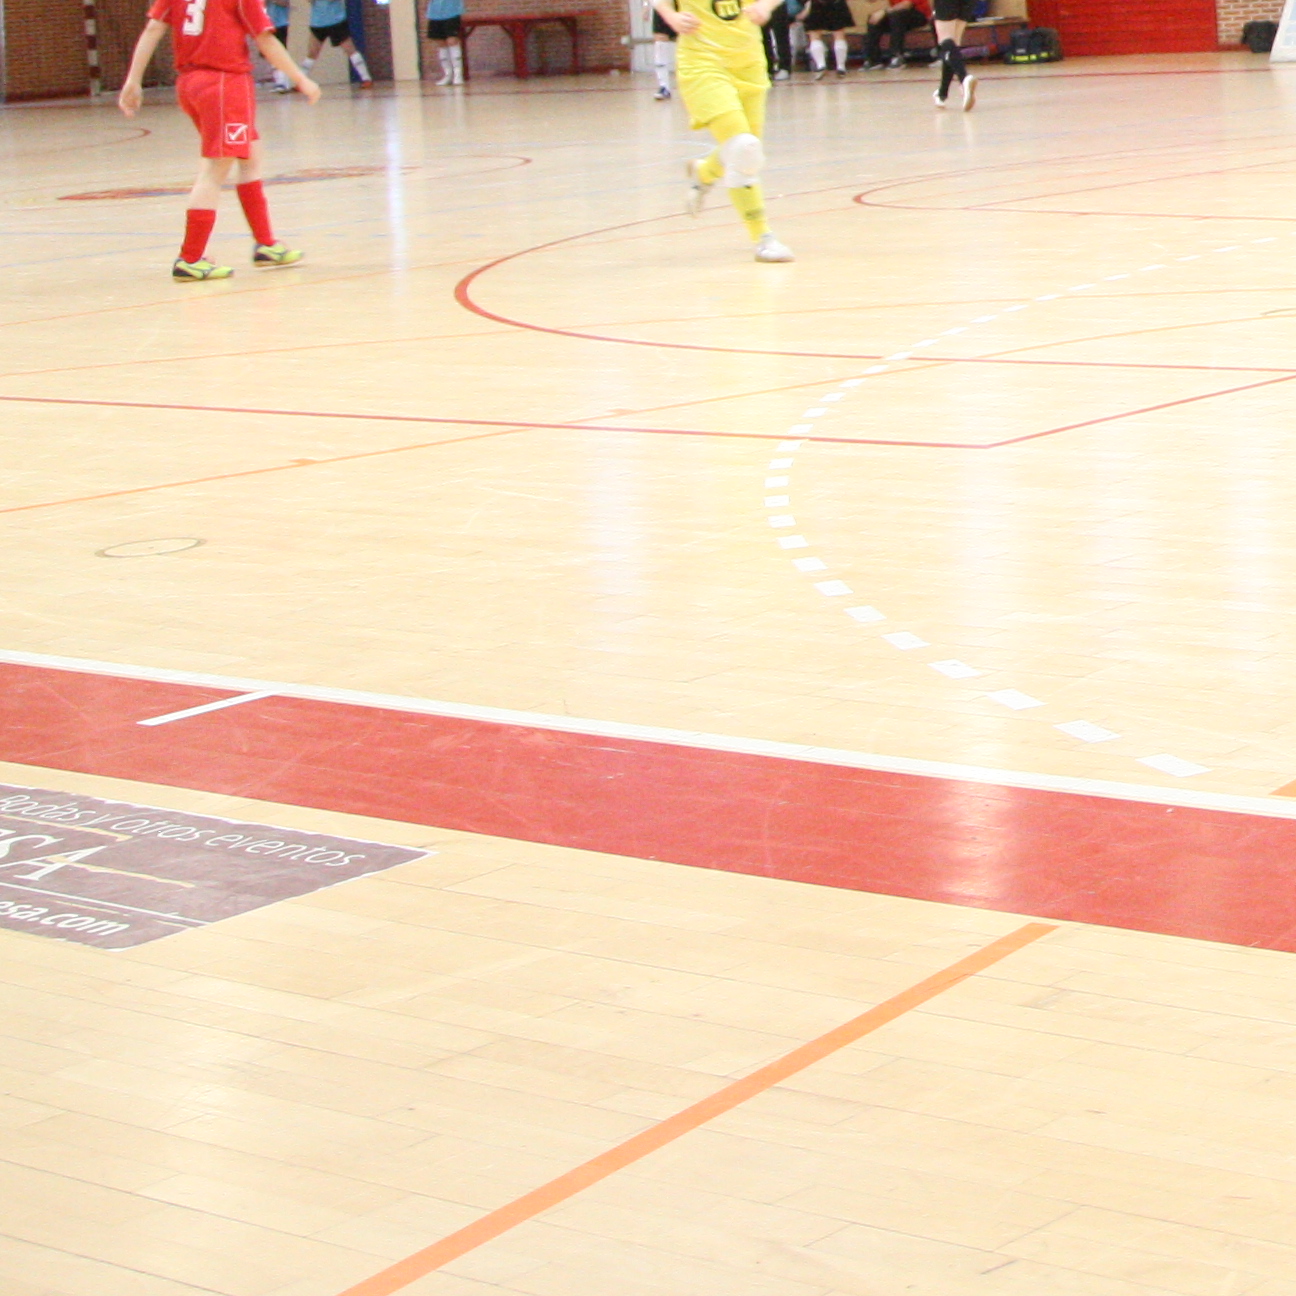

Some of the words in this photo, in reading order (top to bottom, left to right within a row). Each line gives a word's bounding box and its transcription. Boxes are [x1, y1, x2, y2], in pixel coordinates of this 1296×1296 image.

[0, 829, 108, 882] SA
[110, 814, 217, 842] otros
[205, 831, 366, 868] eventos
